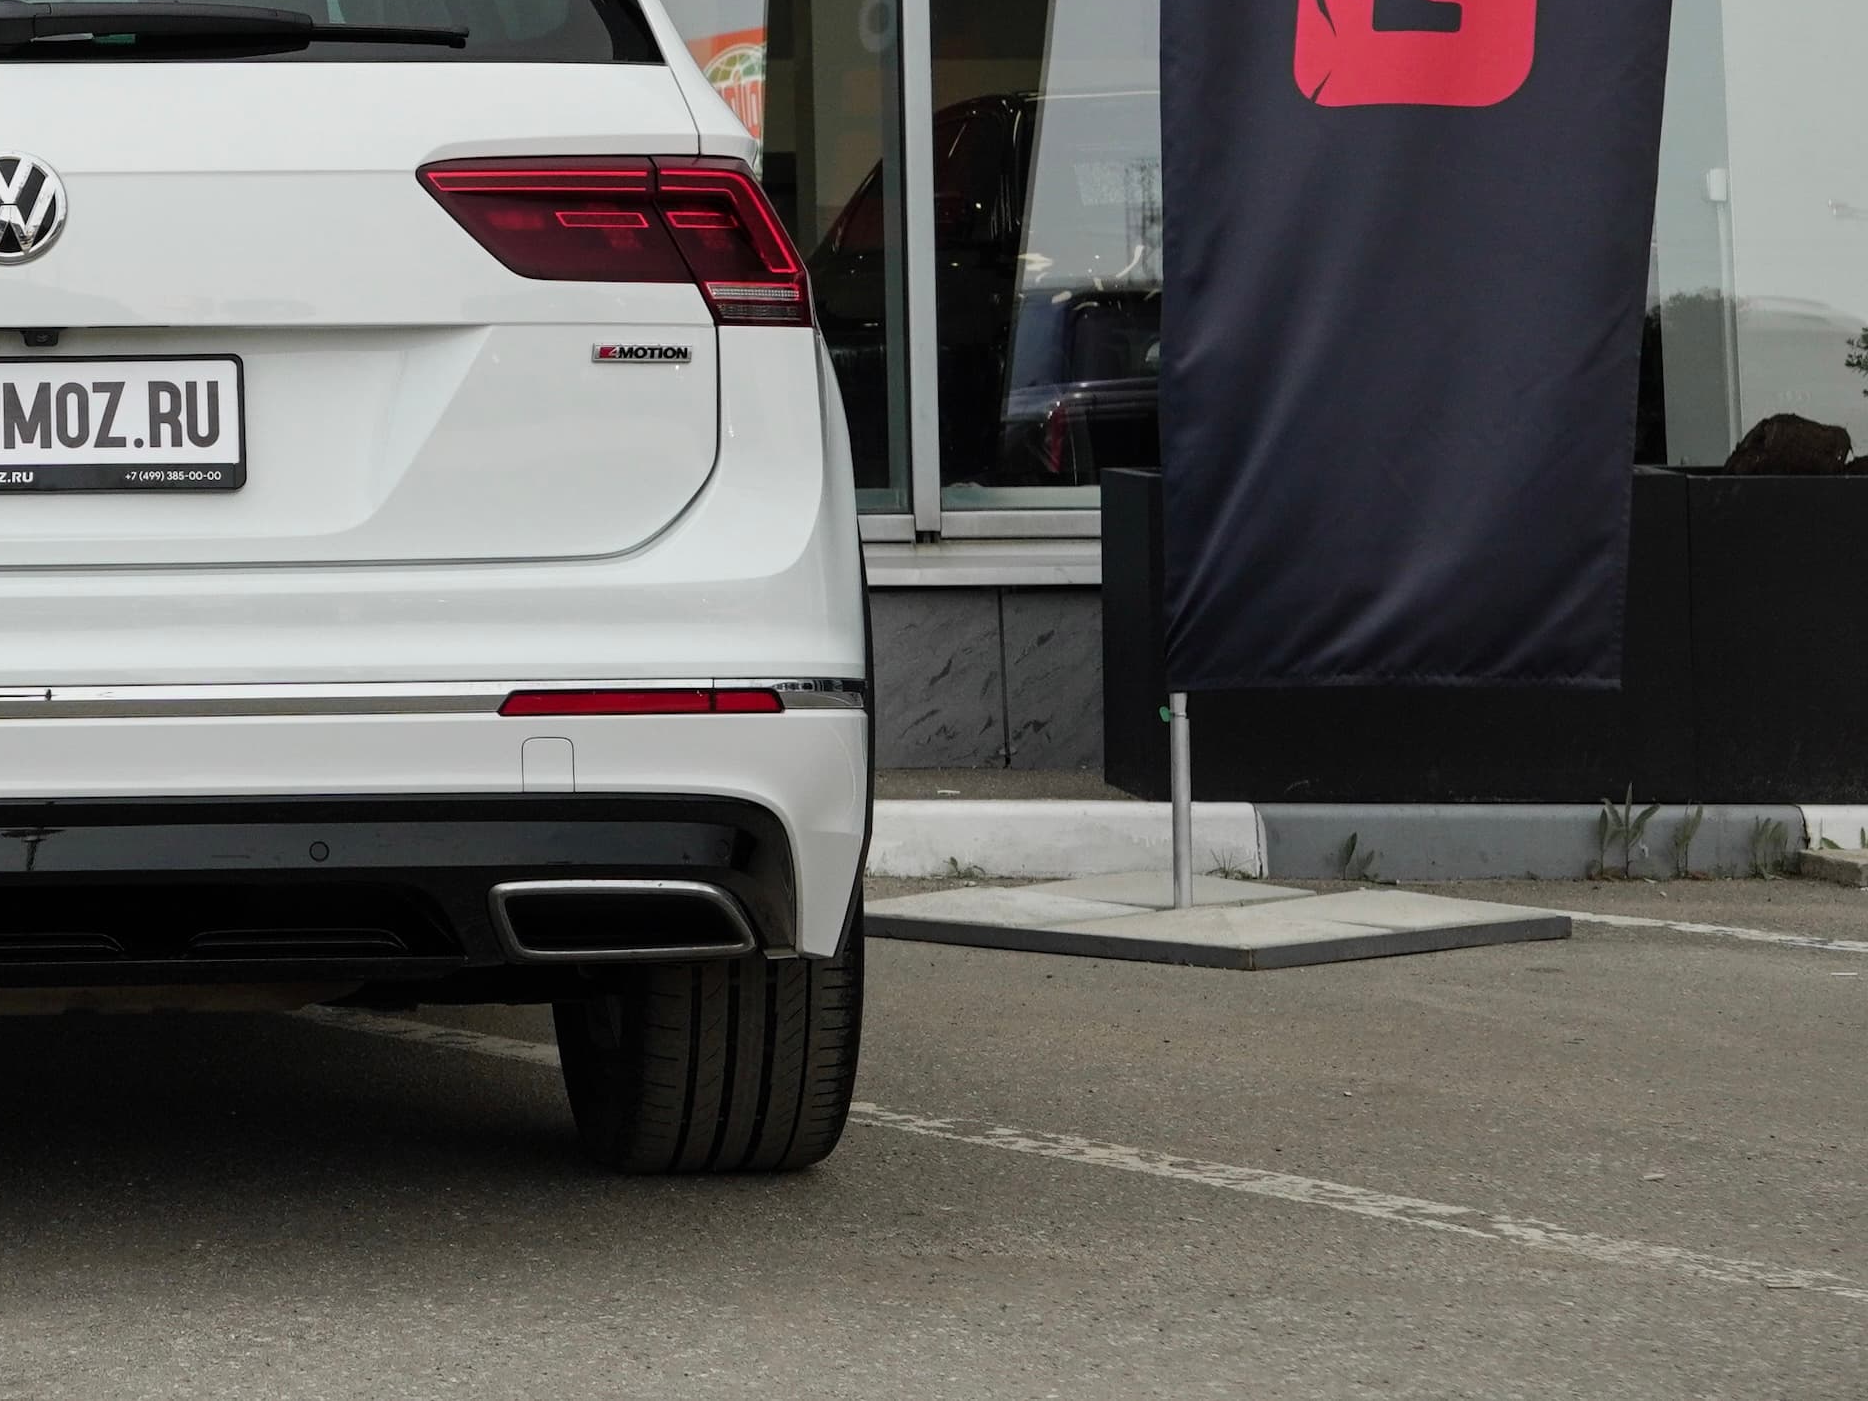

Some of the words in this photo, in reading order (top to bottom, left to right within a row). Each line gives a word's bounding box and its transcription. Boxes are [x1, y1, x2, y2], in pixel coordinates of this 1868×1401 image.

[125, 471, 137, 481] +7
[138, 470, 165, 482] (499)
[166, 470, 222, 481] 385-00-00
